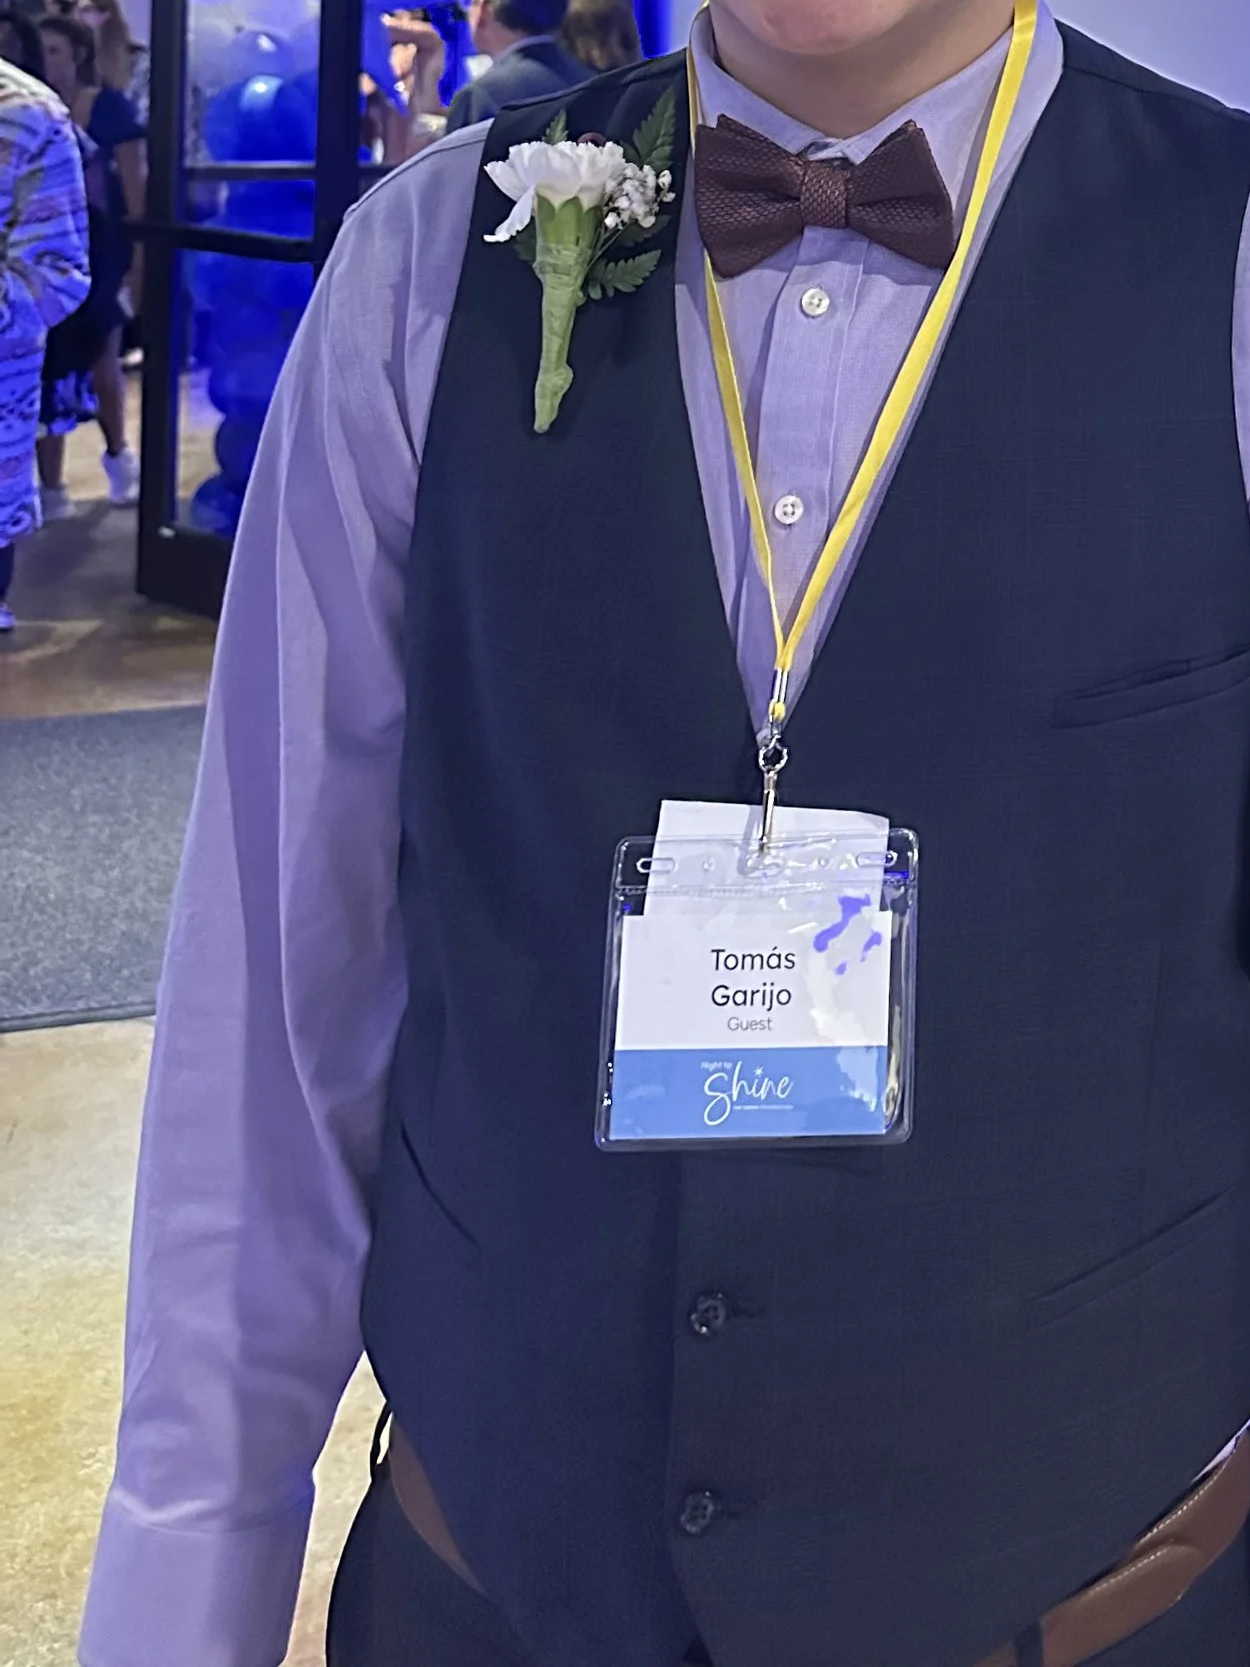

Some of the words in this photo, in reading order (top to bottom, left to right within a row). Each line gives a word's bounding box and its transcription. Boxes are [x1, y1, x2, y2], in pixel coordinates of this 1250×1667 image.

[710, 945, 796, 971] Tomás
[711, 981, 792, 1012] Garijo
[727, 1016, 773, 1032] Guest
[703, 1060, 796, 1126] Shine
